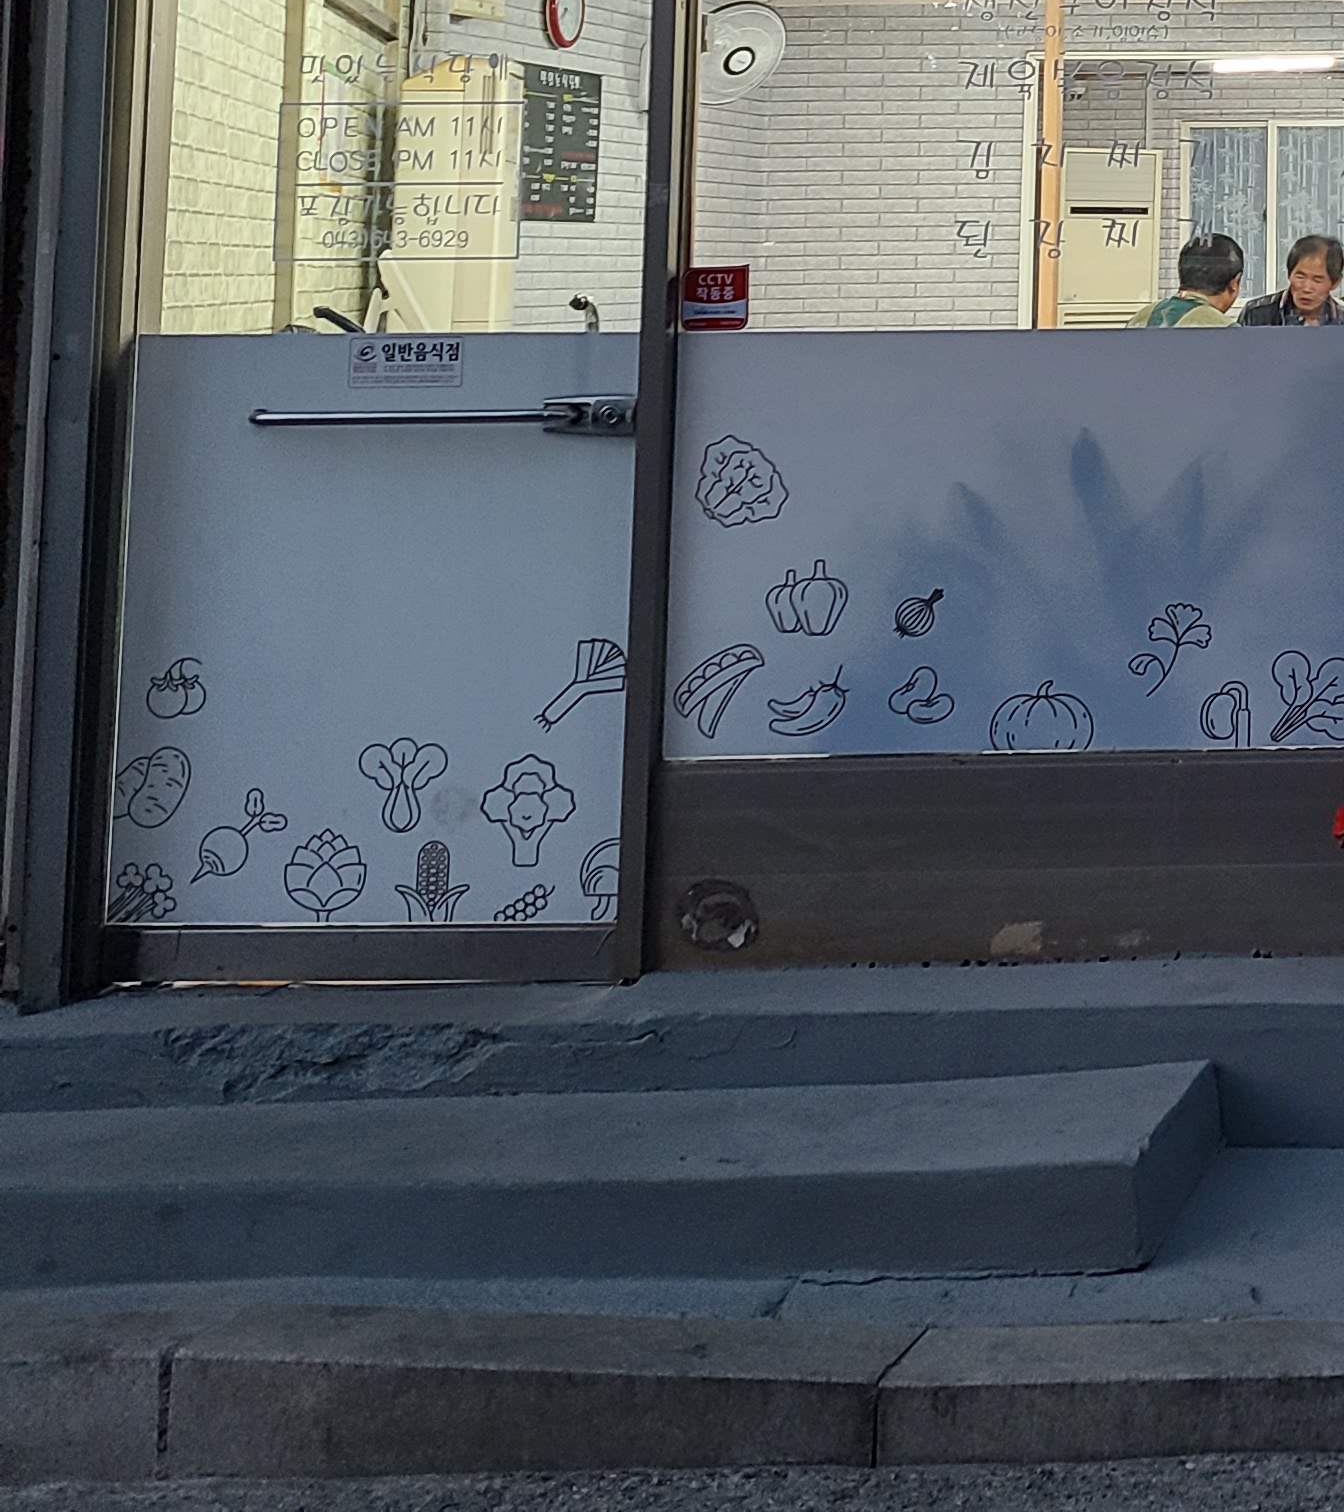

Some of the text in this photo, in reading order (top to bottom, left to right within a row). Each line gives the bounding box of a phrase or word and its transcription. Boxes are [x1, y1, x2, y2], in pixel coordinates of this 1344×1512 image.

[396, 115, 436, 137] AM
[295, 148, 377, 173] CLOSE
[395, 148, 434, 170] PM
[450, 148, 502, 170] 11시
[698, 273, 734, 285] CCTV
[696, 286, 735, 301] 작동중
[381, 342, 460, 362] 일반음식점
